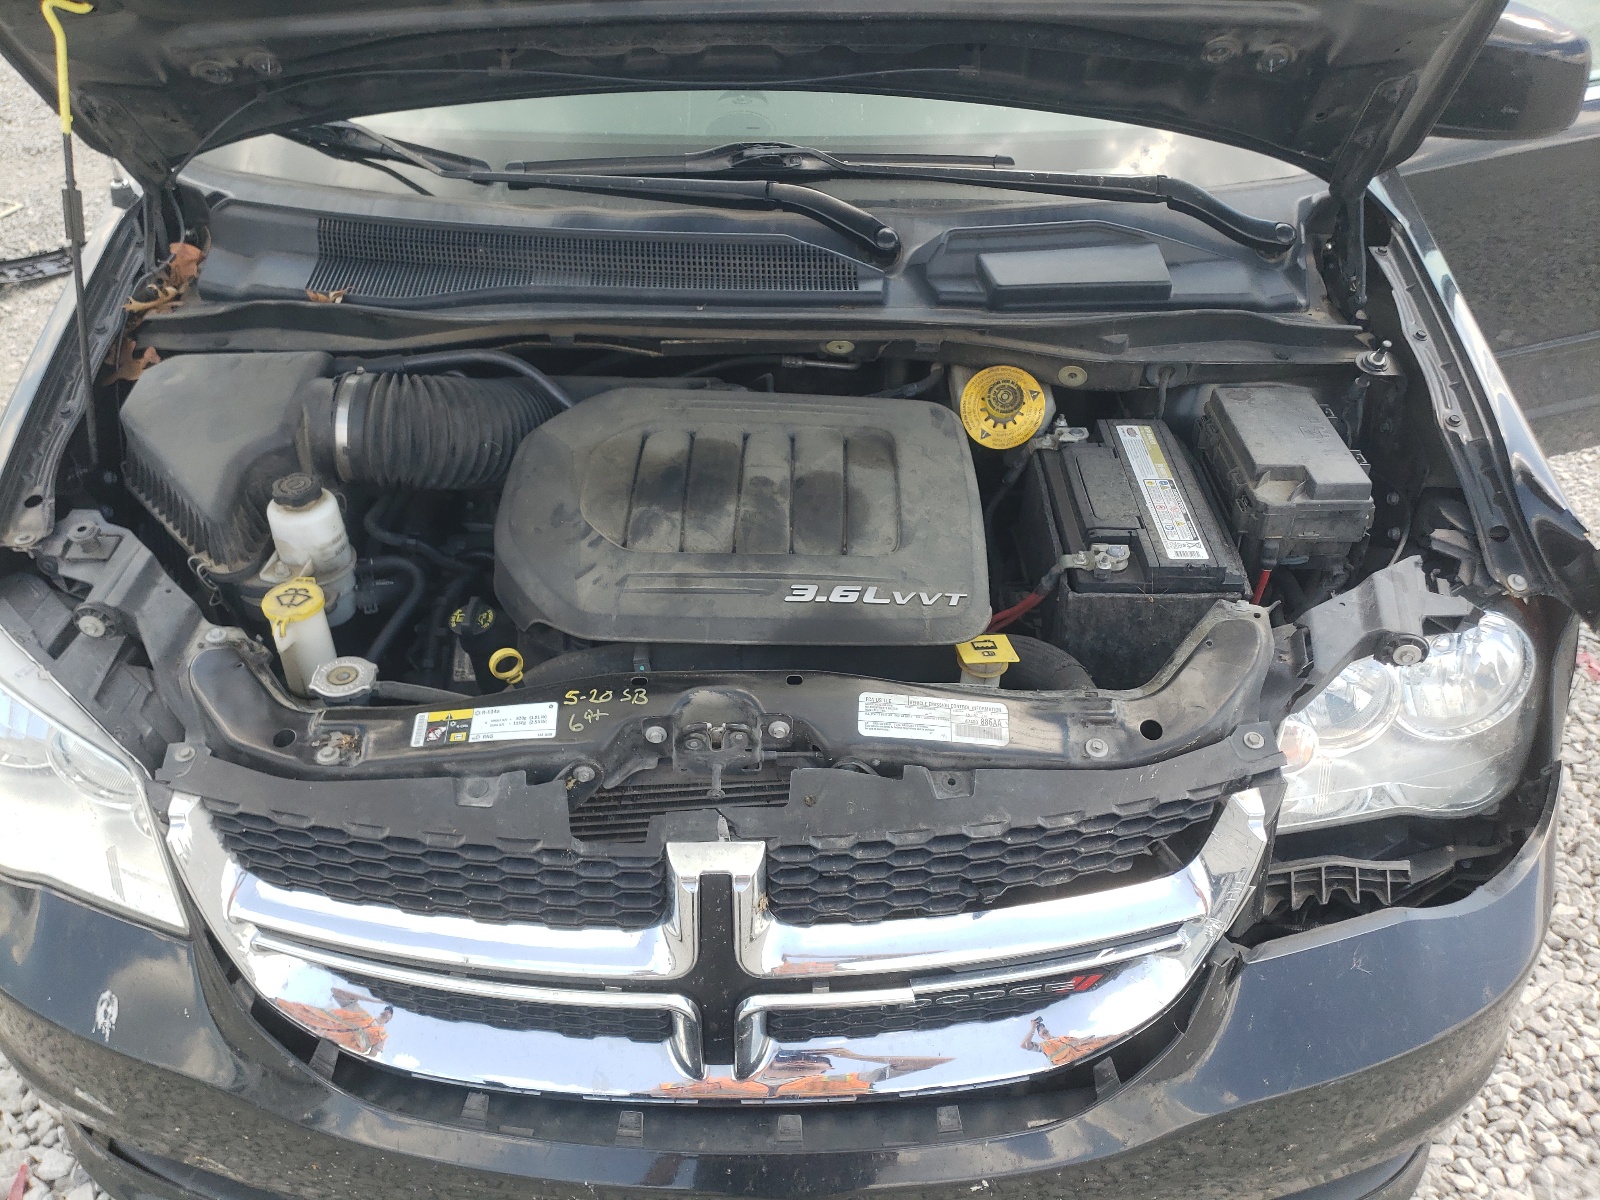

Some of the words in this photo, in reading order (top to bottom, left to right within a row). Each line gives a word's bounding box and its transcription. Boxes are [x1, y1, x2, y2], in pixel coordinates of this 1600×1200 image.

[784, 584, 891, 605] 3.6L
[892, 591, 968, 607] VVT
[563, 688, 613, 705] 5-20
[620, 688, 649, 705] SB
